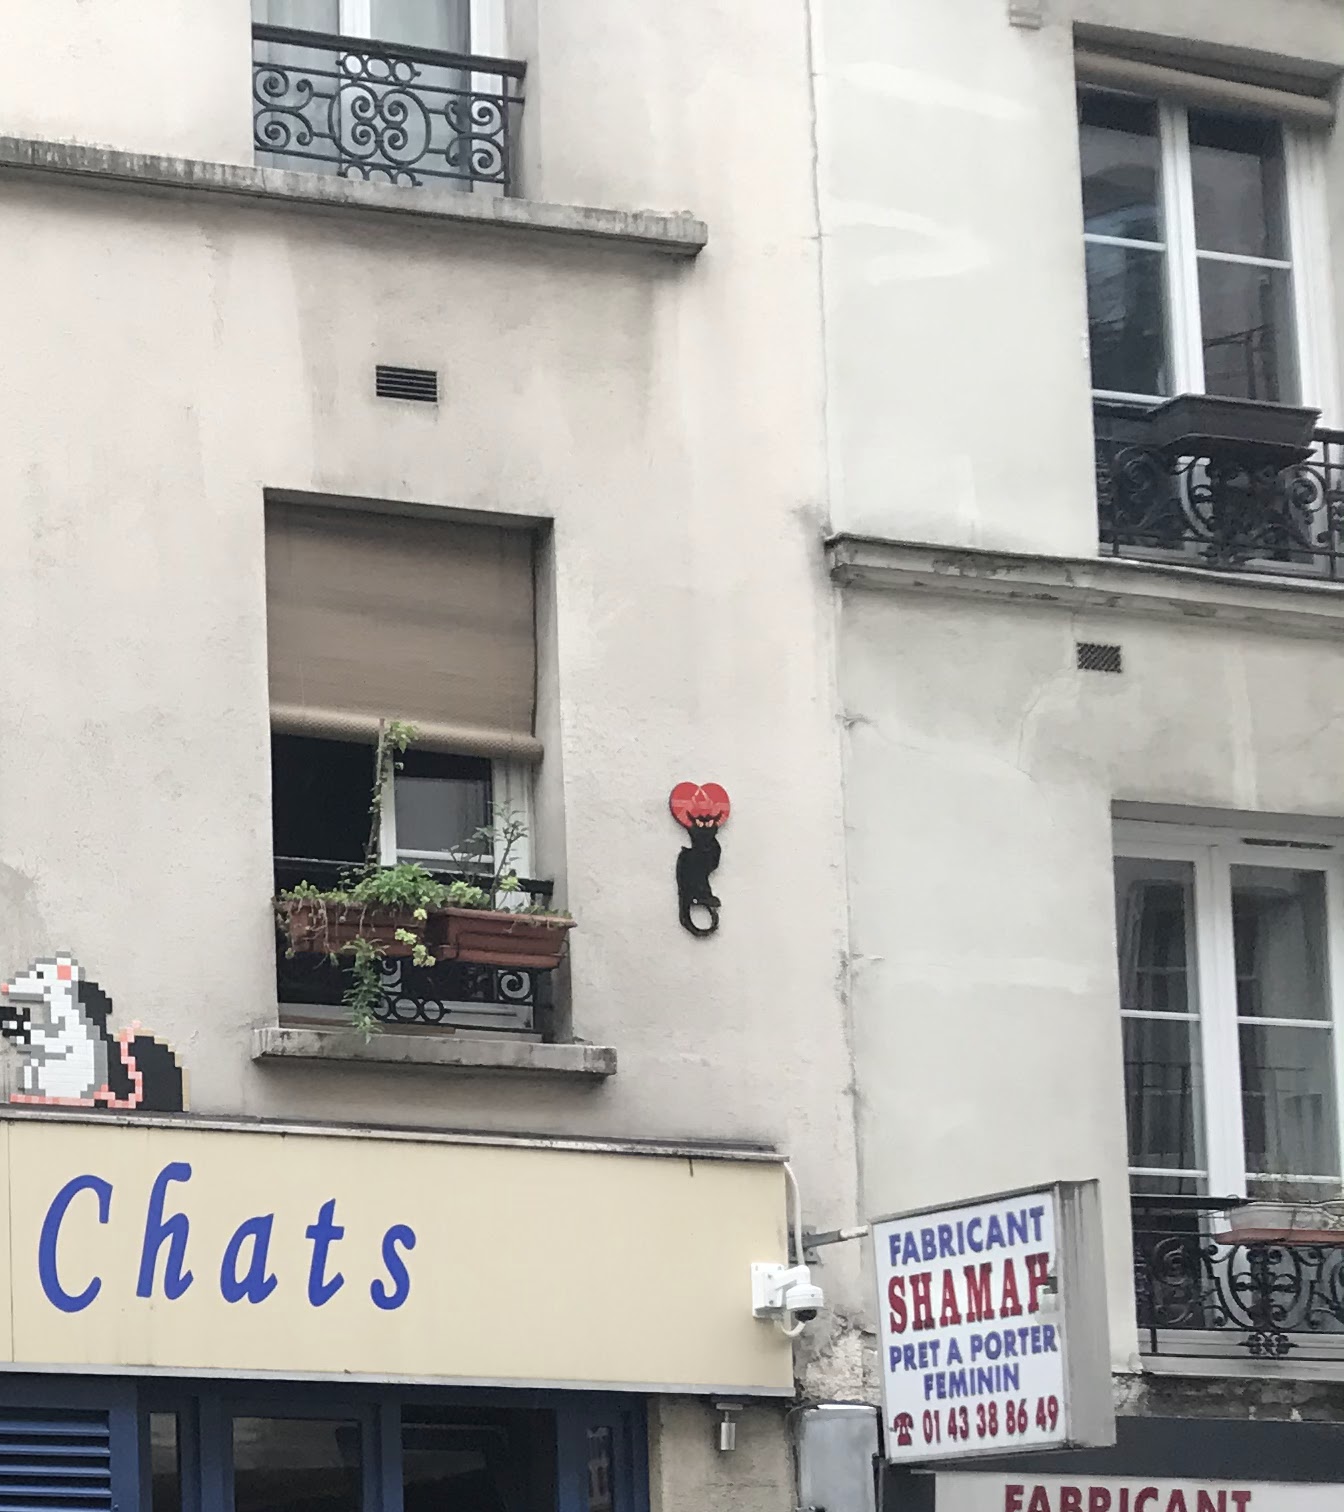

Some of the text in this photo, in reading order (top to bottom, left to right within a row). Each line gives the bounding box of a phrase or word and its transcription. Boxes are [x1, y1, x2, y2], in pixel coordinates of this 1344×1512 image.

[38, 1162, 416, 1313] Chats
[889, 1206, 1044, 1266] FABRICANT
[889, 1324, 1058, 1372] PRET A PORTER
[924, 1363, 1020, 1400] FEMININ
[923, 1395, 1060, 1443] 01 43 38 86 49
